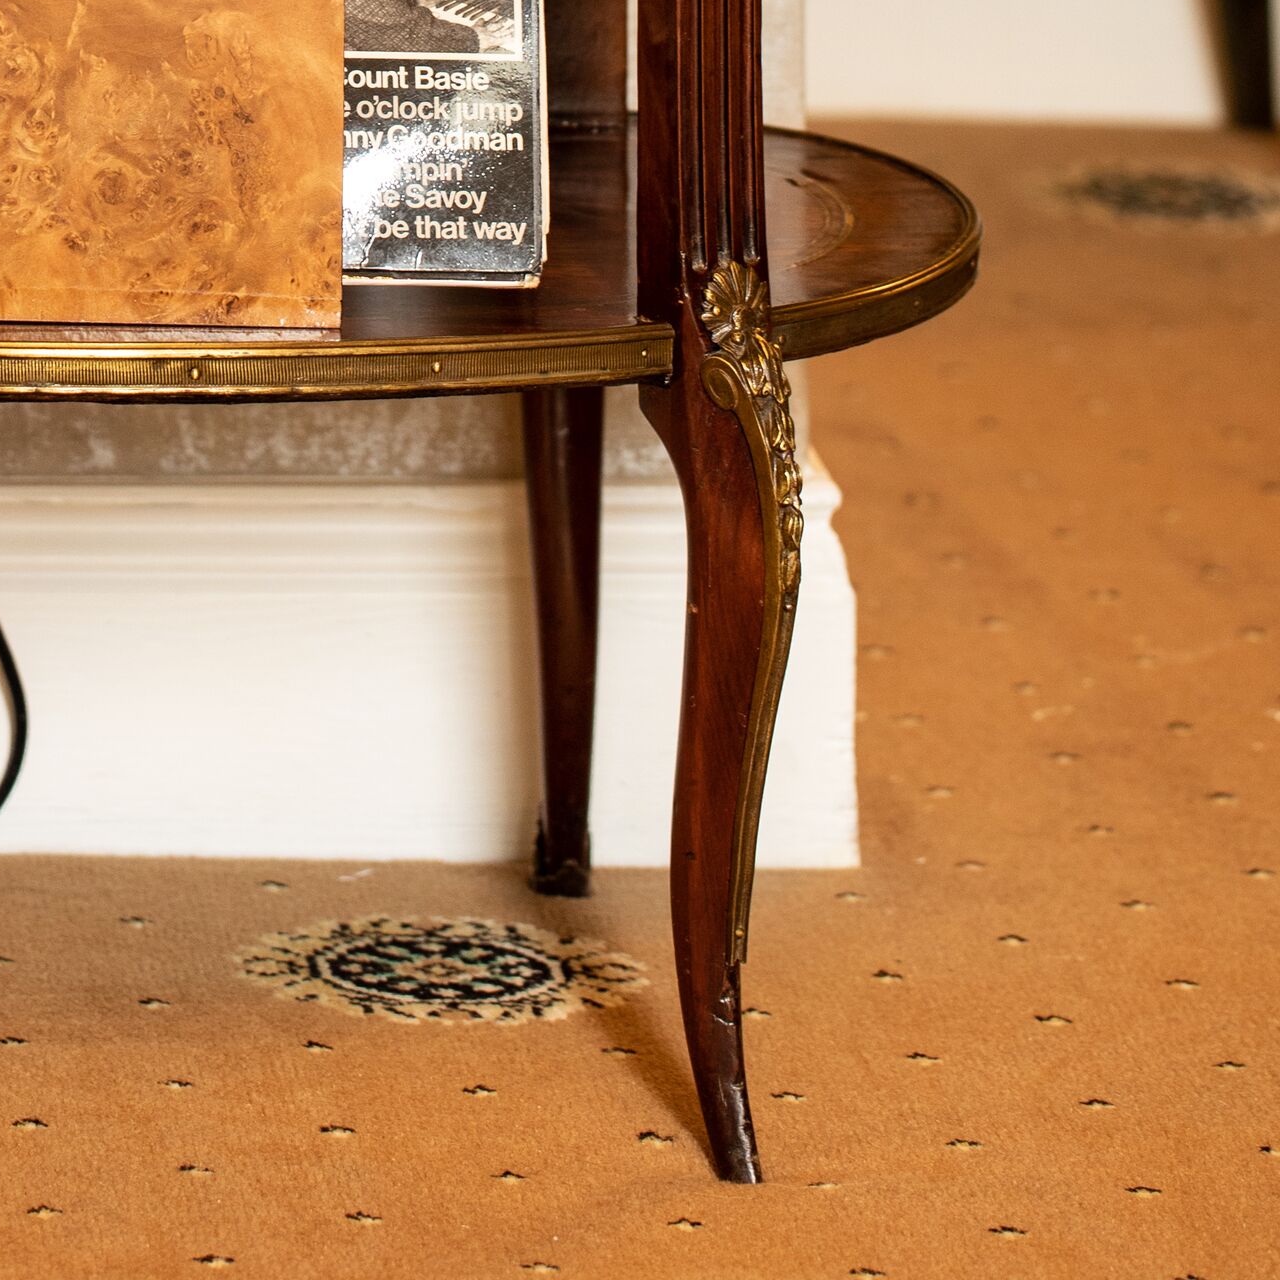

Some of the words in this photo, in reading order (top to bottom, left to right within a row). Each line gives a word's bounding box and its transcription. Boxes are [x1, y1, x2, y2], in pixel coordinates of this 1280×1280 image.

[343, 65, 409, 90] ount
[414, 66, 490, 91] Basie
[356, 96, 450, 120] o'clock
[454, 99, 524, 126] jump
[387, 124, 524, 151] Goodman
[405, 183, 487, 214] Savoy
[414, 215, 468, 240] that
[472, 221, 527, 246] way
